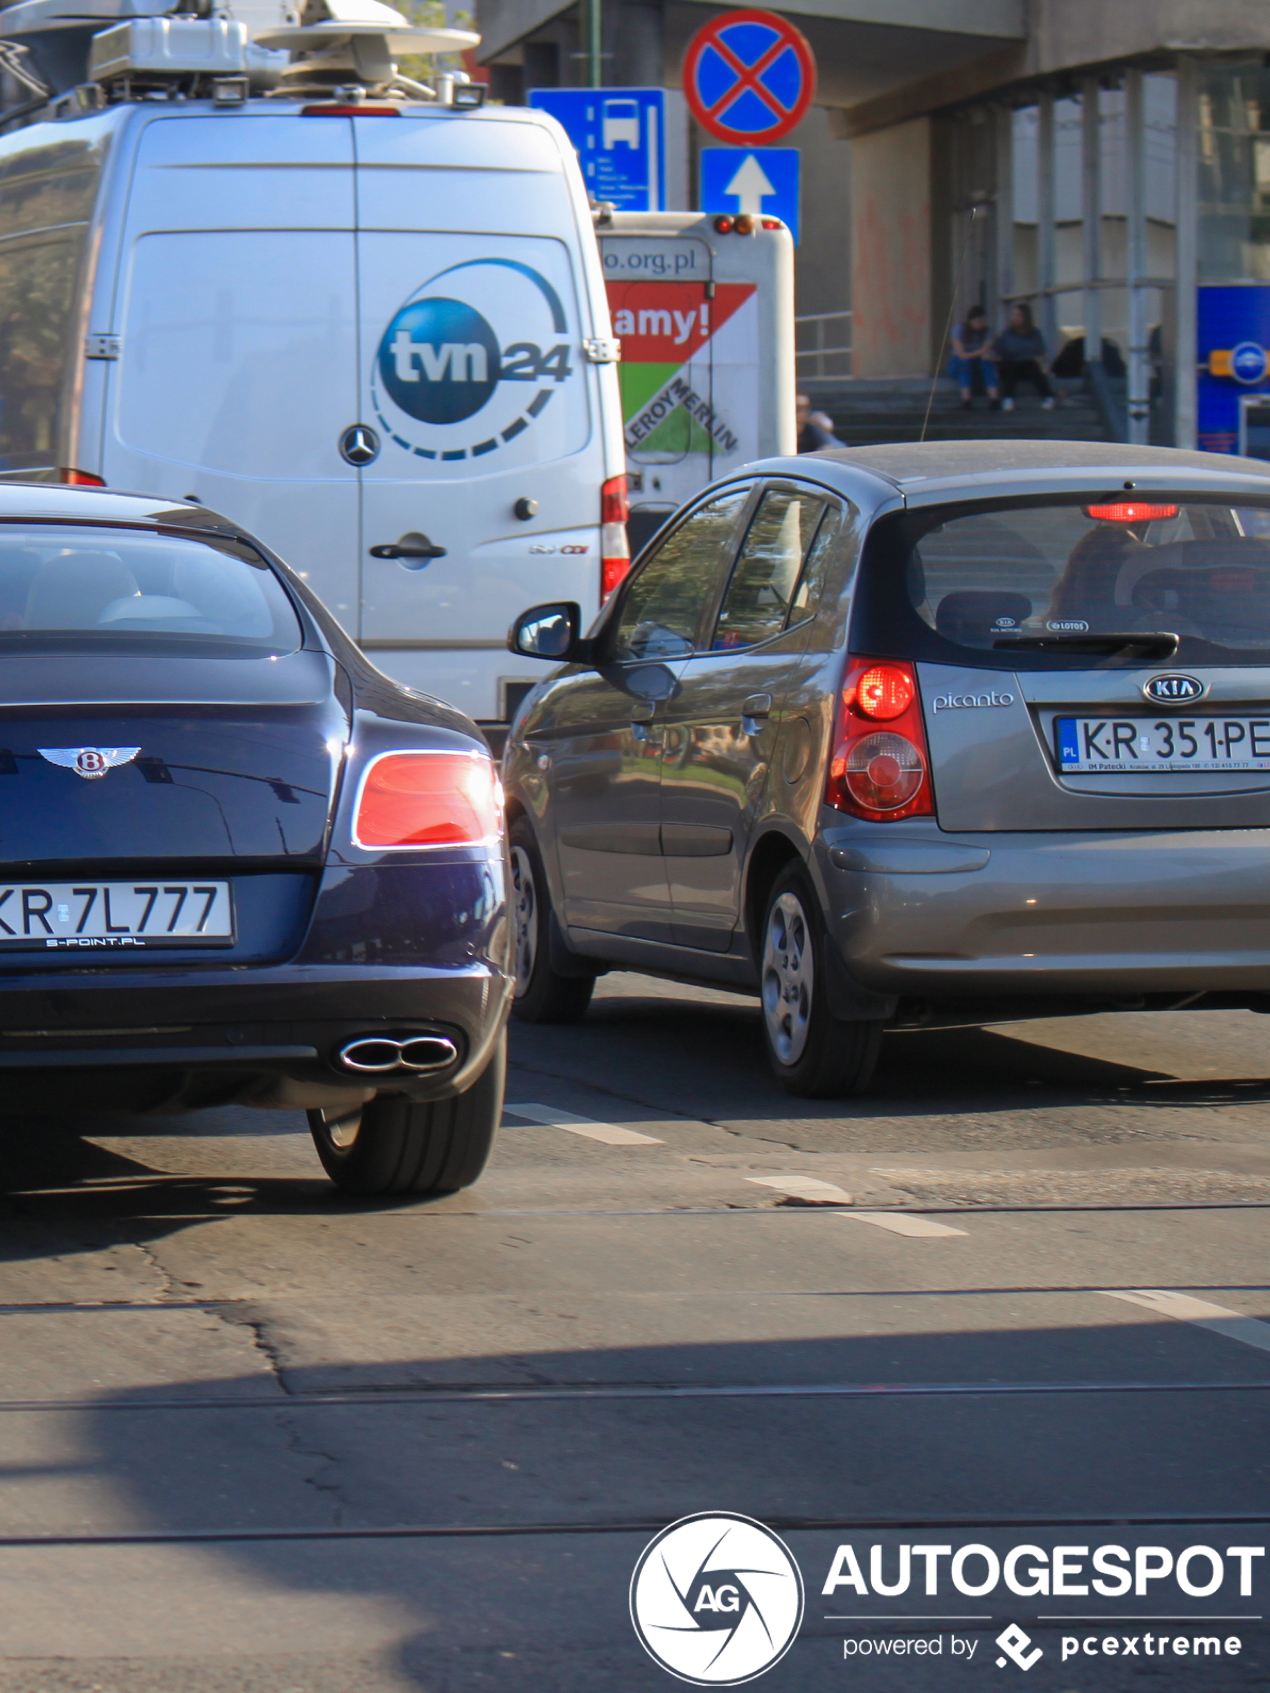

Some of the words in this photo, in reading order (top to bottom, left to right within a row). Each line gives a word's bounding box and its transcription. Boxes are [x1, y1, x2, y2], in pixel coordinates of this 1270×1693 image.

[603, 249, 696, 274] o.org.pl
[610, 303, 709, 345] amy!
[625, 389, 676, 450] LEROY
[670, 376, 739, 451] MERLIN
[1060, 622, 1084, 631] LOTOS
[932, 691, 1015, 715] picanto
[1156, 680, 1195, 696] KIA
[1063, 748, 1077, 757] PL
[1083, 721, 1139, 760] KR
[71, 886, 218, 934] 7L777
